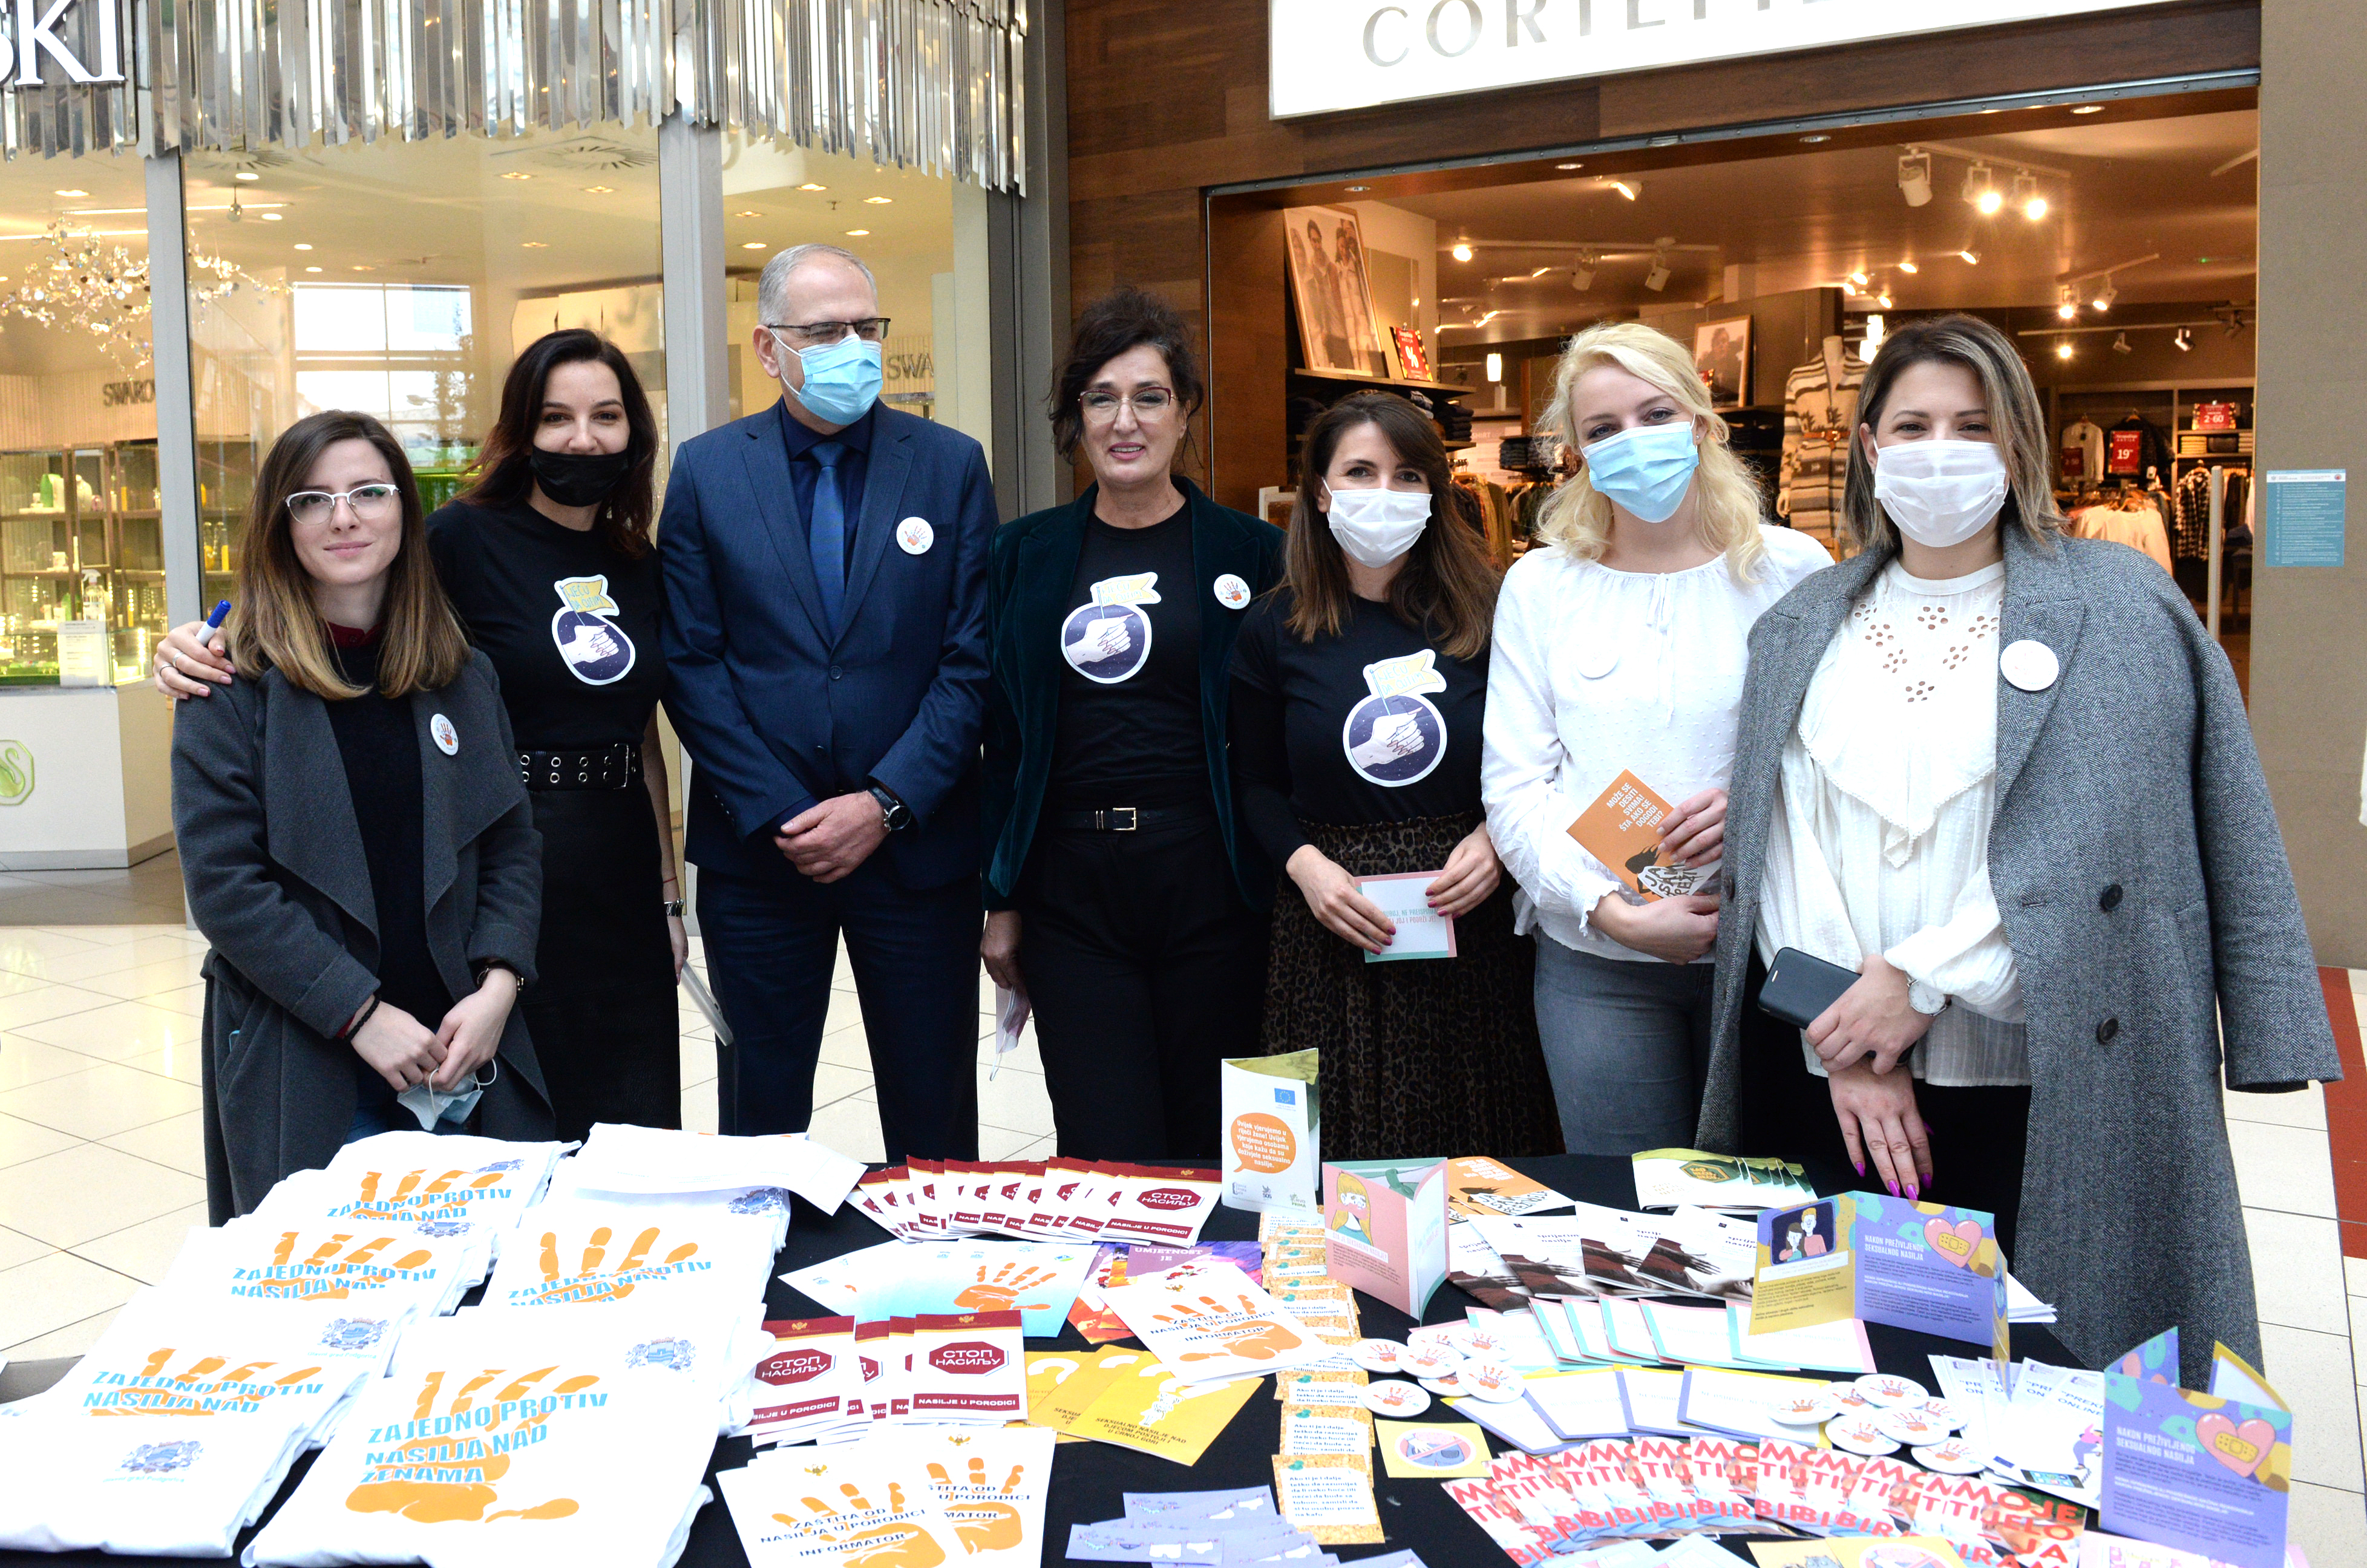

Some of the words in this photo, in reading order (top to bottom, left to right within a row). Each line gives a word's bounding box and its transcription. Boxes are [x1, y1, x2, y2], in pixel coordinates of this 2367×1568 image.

[0, 0, 125, 85] KI
[1622, 782, 1631, 792] SE
[1619, 789, 1639, 808] DESITI
[1631, 808, 1644, 821] AKO
[1642, 799, 1652, 809] SE
[1635, 806, 1658, 827] DOGODI
[1646, 811, 1664, 827] TEBI?
[327, 1195, 421, 1217] ZAJEDNO
[429, 1189, 511, 1204] PROTIV
[421, 1208, 467, 1221] NAD
[1075, 1220, 1101, 1229] NASILJ
[1151, 1226, 1188, 1235] PORODICI
[1865, 1235, 1883, 1245] NAKON
[1885, 1236, 1924, 1252] PREŽIVLJENOG
[1865, 1244, 1899, 1256] SEKSUALNOG
[1900, 1250, 1923, 1261] NASILJA
[232, 1264, 339, 1281] ZAJEDNO
[346, 1264, 436, 1281] PROTIV
[231, 1278, 330, 1299] NASILJA
[1171, 1314, 1222, 1325] ZAŠTITA
[1185, 1326, 1265, 1342] INFORMATOR
[943, 1350, 992, 1358] СТОП
[762, 1364, 827, 1378] НАСИЉУ
[770, 1356, 820, 1370] СТОП
[93, 1371, 214, 1394] ZAJEDNO
[220, 1380, 324, 1397] PROTIV
[83, 1391, 193, 1409] NASILJA
[200, 1397, 260, 1413] NAD
[790, 1402, 836, 1414] PORODICI
[367, 1406, 491, 1444] ZAJEDNO
[500, 1393, 608, 1422] PROTIV
[2117, 1426, 2142, 1440] NAKON
[365, 1439, 484, 1466] NASILJA
[492, 1425, 548, 1455] NAD
[761, 1527, 828, 1543] NASILJA
[850, 1509, 926, 1529] PORODICI
[791, 1513, 859, 1529] ZAŠTITA
[865, 1508, 886, 1517] OD
[799, 1533, 906, 1557] INFORMATOR
